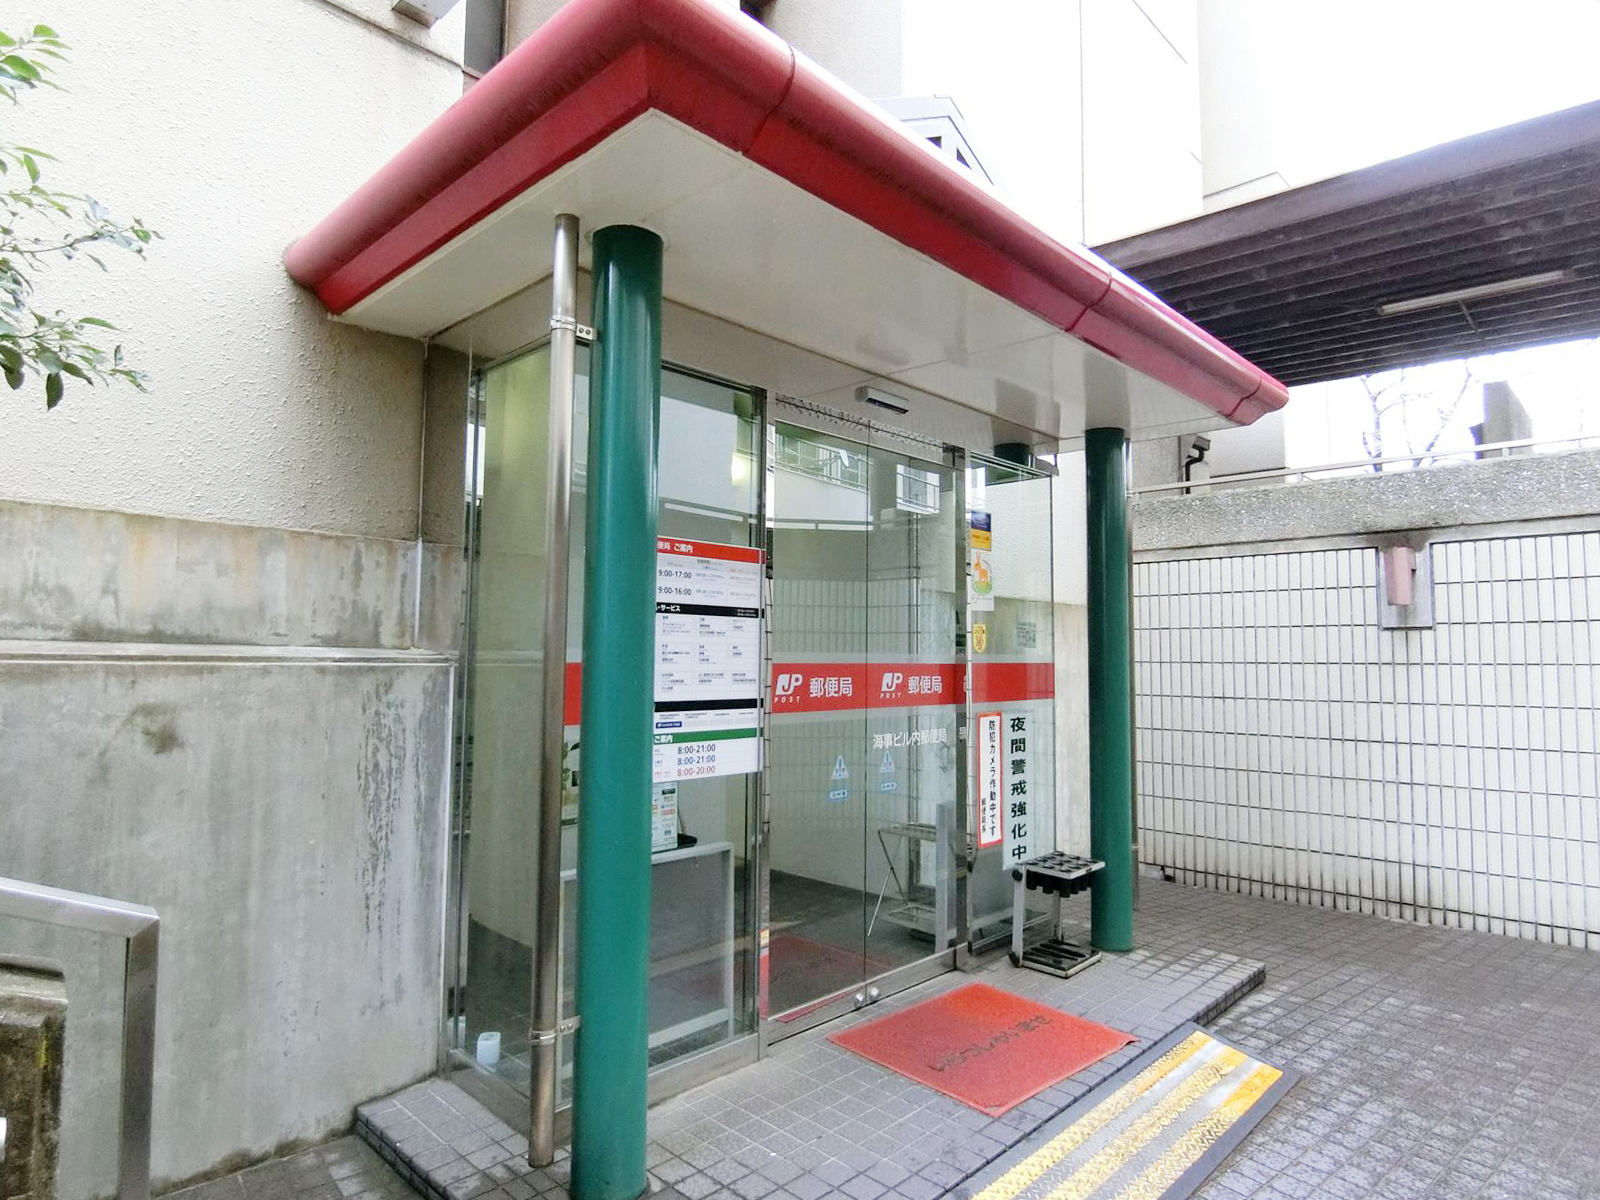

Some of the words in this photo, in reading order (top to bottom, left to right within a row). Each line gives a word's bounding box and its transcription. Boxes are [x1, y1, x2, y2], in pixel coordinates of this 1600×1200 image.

[673, 543, 694, 554] ご案内
[658, 569, 692, 579] 9:00-17:00
[657, 586, 692, 596] 9:00-16:00
[809, 676, 853, 698] 郵便局
[908, 675, 943, 695] 郵便局
[774, 696, 801, 704] POST
[872, 728, 947, 750] 海事ビル内郵便局
[677, 744, 716, 755] 8:00-21:00
[677, 755, 716, 766] 8:00-21:00
[677, 765, 716, 777] 8:00-20:00
[988, 719, 997, 837] 防犯カメラ作動中です
[1010, 716, 1027, 860] 夜間警戒強化中
